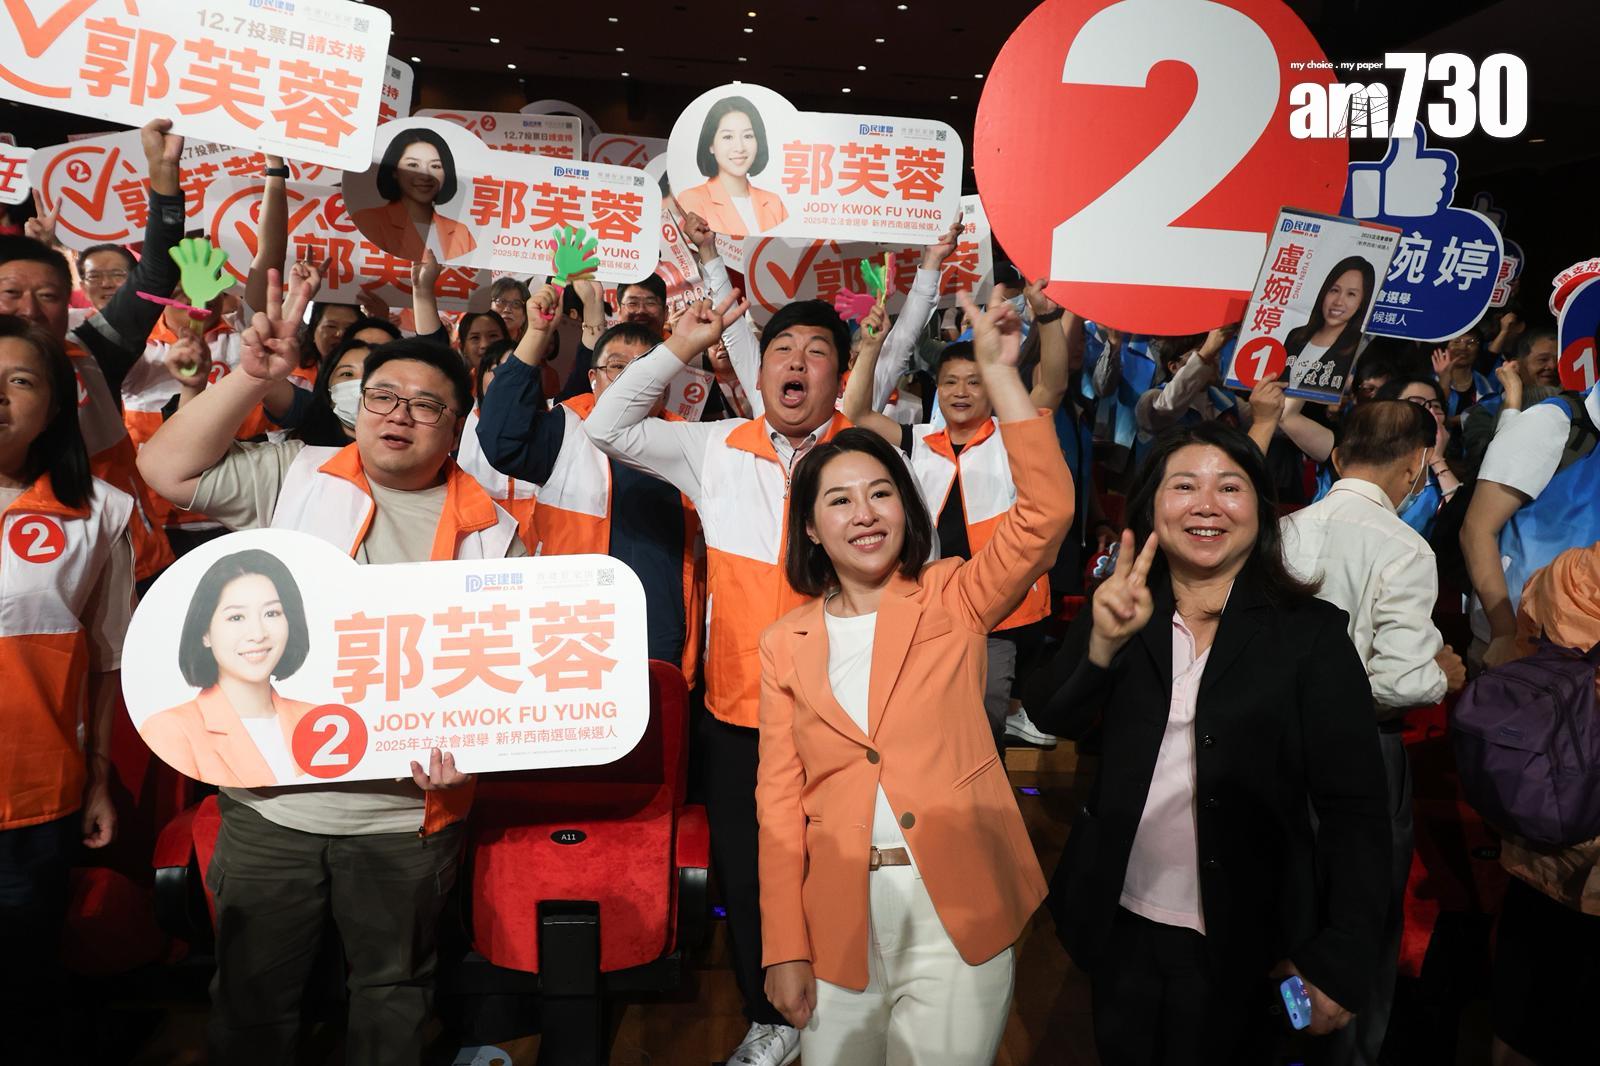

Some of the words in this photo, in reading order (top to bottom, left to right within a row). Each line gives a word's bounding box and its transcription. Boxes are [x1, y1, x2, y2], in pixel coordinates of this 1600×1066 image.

[196, 9, 367, 63] 12.7投票日請支持
[79, 17, 364, 148] 郭芙蓉
[484, 118, 494, 128] 2
[1050, 0, 1281, 292] 2
[70, 160, 89, 181] 2
[781, 139, 946, 203] 郭芙蓉
[469, 175, 644, 243] 郭芙蓉
[803, 202, 838, 214] JODY
[842, 204, 881, 216] KWOK
[886, 206, 901, 217] FU
[906, 208, 941, 220] YUNG
[1292, 220, 1321, 233] 民建聯
[492, 234, 530, 247] JODY
[602, 246, 639, 259] YUNG
[1250, 243, 1305, 335] 盧婉婷
[1372, 310, 1407, 326] 候選人
[1250, 345, 1273, 382] 1
[1573, 347, 1597, 391] 1
[686, 384, 701, 401] 2
[21, 521, 57, 558] 2
[484, 572, 522, 585] 民建聯
[332, 598, 620, 705] 郭芙蓉
[373, 711, 436, 732] JODY
[442, 707, 512, 728] KWOK
[519, 704, 547, 722] FU
[554, 700, 618, 721] YUNG
[310, 714, 351, 767] 2
[375, 732, 489, 752] 2025年立法會選舉
[496, 725, 619, 746] 新界西南選區候選人
[560, 833, 576, 841] A11
